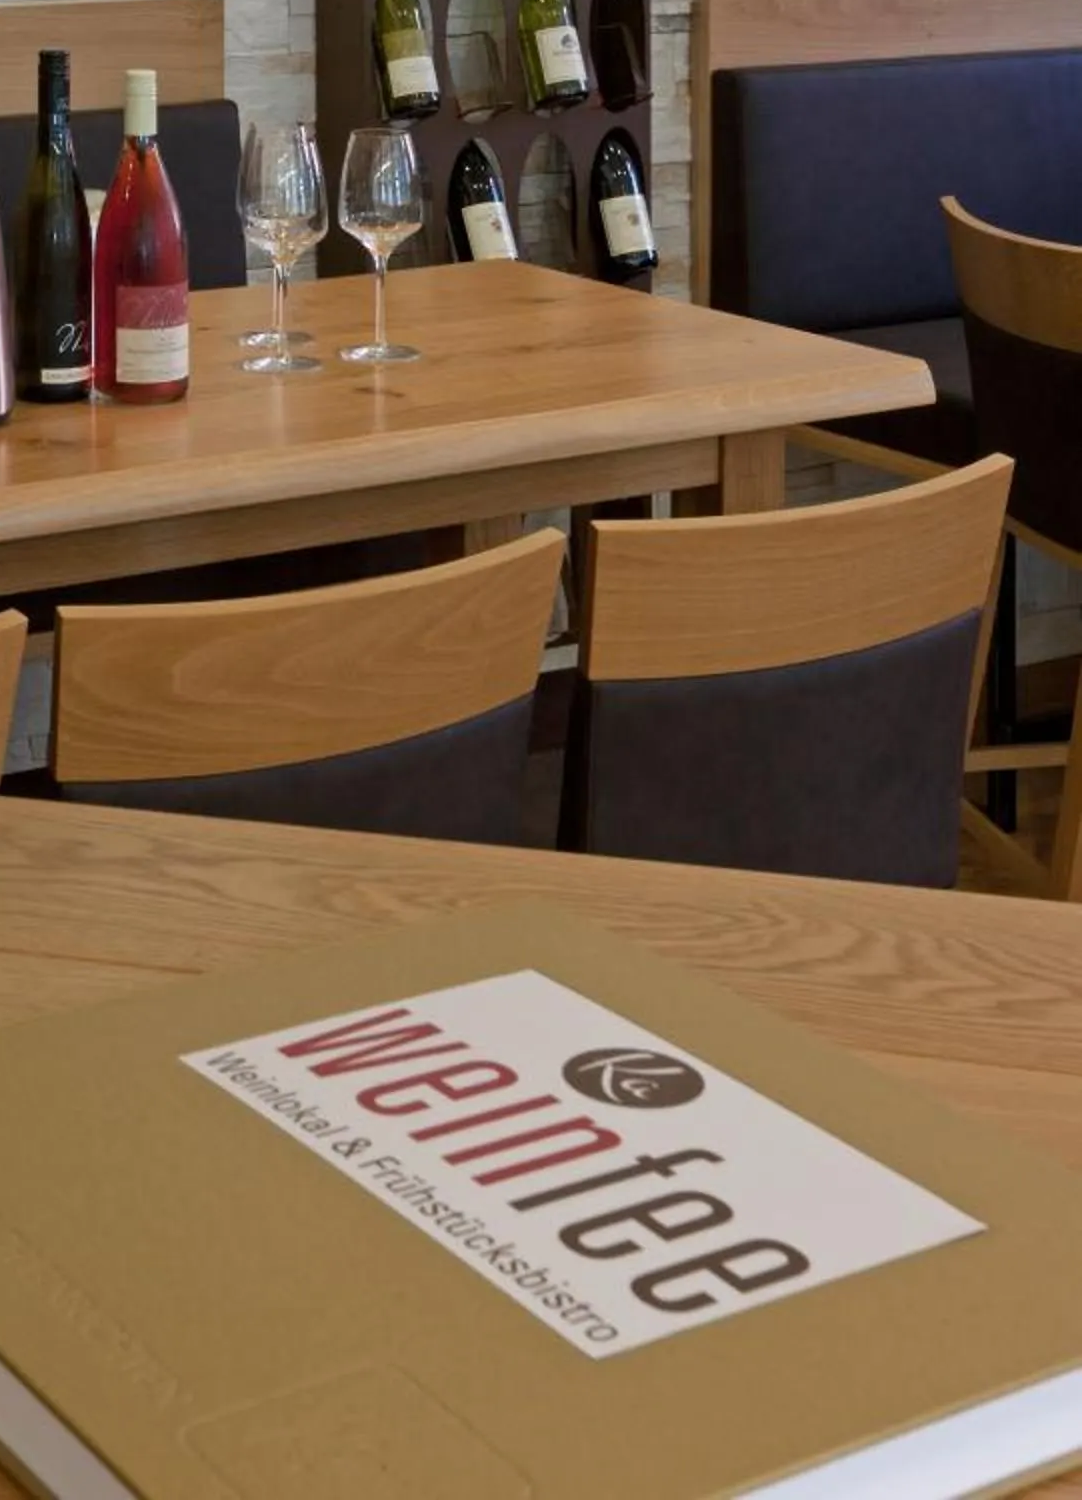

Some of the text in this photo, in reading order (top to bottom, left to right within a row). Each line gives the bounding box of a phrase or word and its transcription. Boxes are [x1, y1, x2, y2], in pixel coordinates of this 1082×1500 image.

[206, 1050, 620, 1343] Weinlokal & Frühstücksbistro
